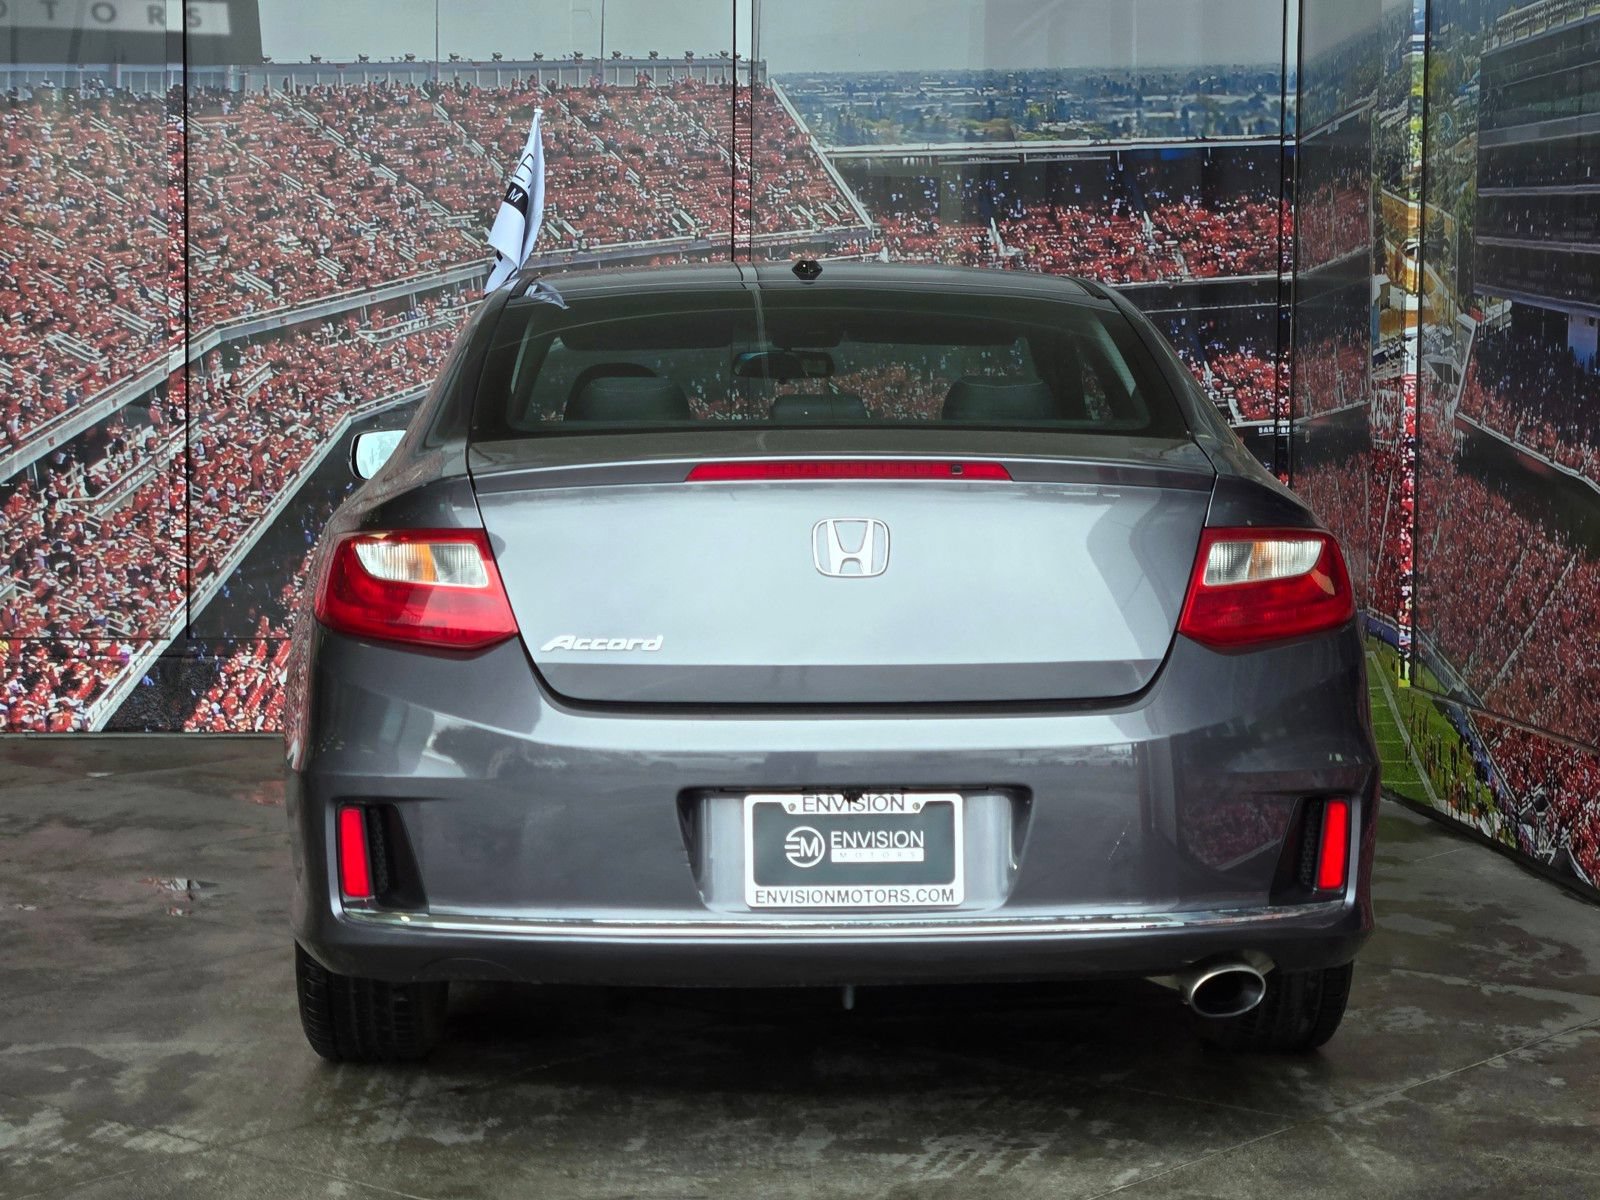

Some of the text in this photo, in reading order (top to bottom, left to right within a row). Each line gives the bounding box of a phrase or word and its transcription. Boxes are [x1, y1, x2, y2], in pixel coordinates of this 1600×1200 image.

[540, 634, 664, 651] Accord
[802, 796, 905, 812] ENVISION
[830, 830, 924, 849] ENVISION
[755, 889, 954, 904] ENVISIONMOTORS.COM
